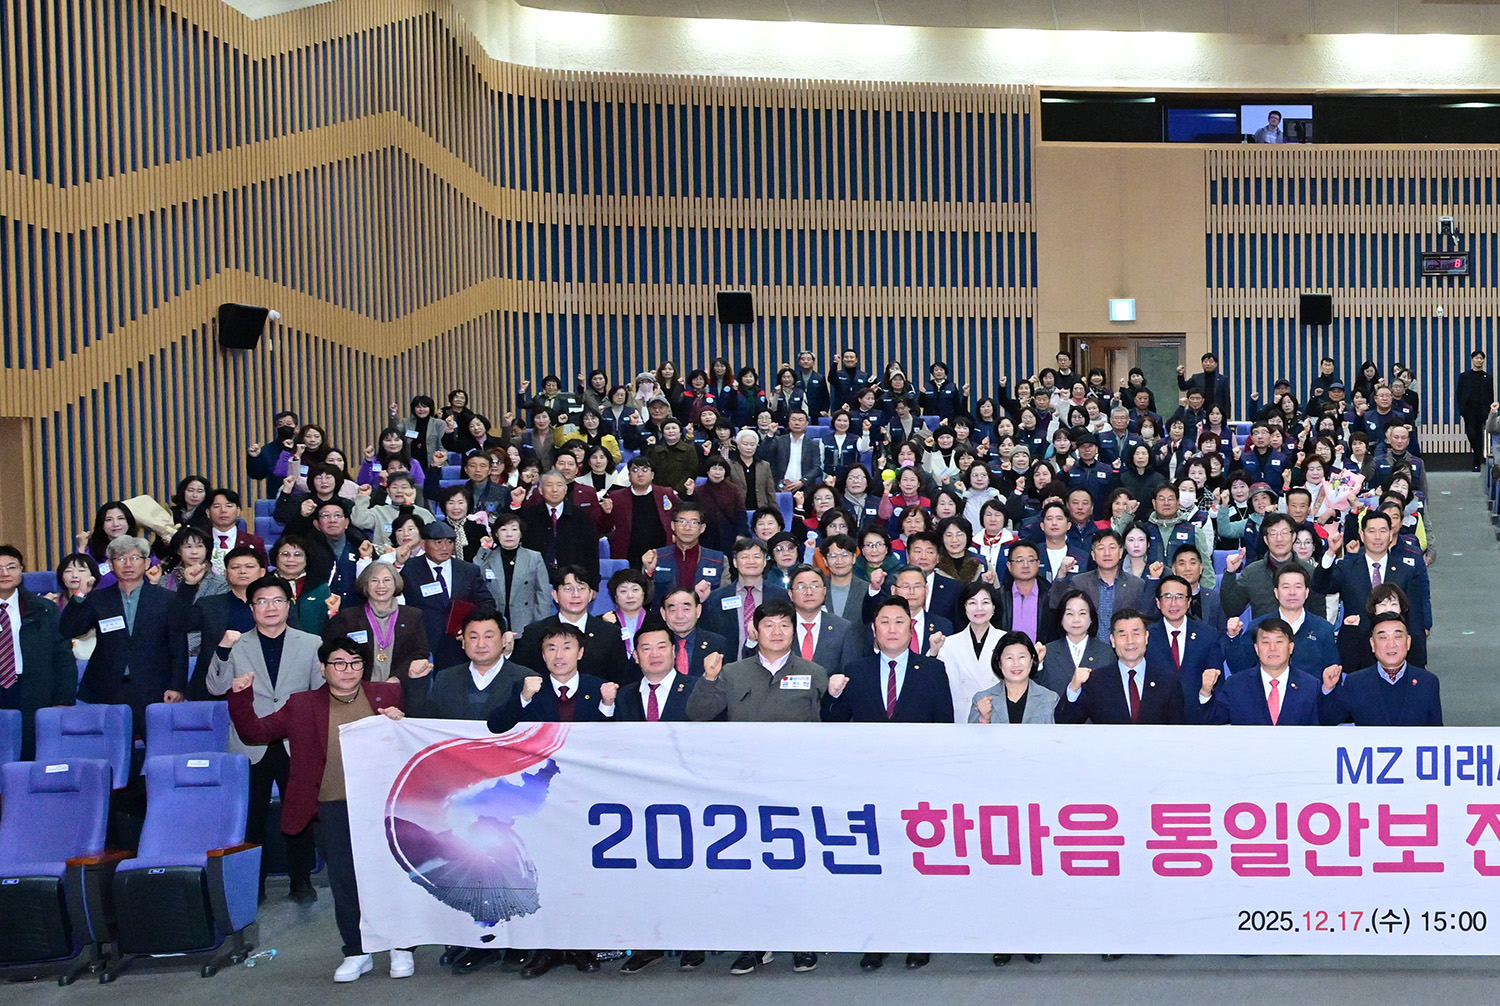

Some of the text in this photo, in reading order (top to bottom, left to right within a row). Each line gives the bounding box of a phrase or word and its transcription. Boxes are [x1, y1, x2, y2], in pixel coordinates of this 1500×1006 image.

[1336, 746, 1404, 785] MZ
[587, 802, 883, 876] 2025년
[900, 801, 1126, 877] 한마음
[1145, 801, 1445, 877] 통일안보
[1237, 907, 1487, 935] 2025.12.17.(수) 15:00
